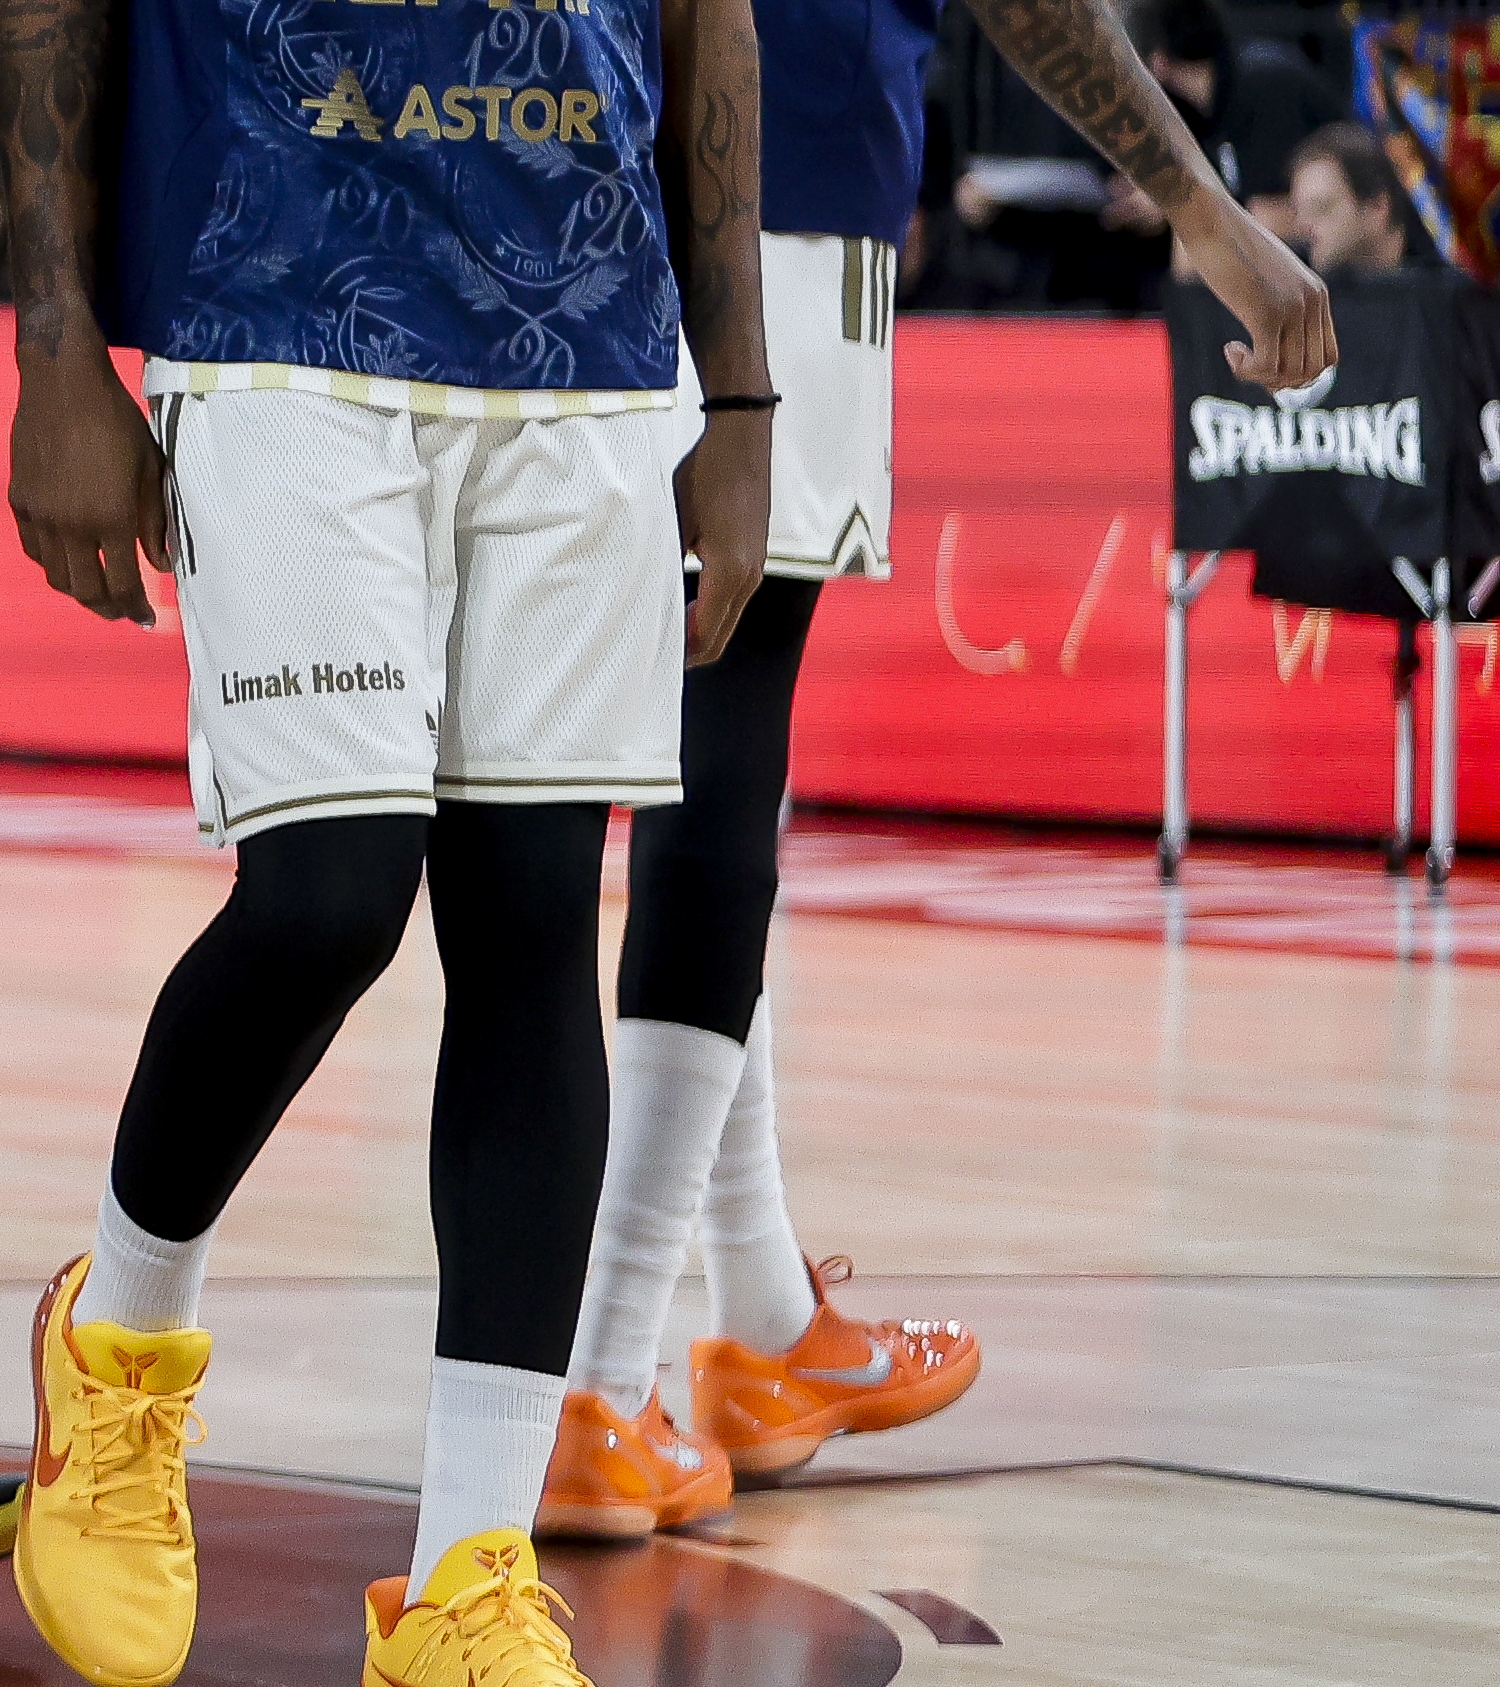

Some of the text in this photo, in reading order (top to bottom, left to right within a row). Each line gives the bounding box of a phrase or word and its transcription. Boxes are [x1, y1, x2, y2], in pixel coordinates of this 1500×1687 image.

[1189, 394, 1427, 485] SPALDING
[220, 660, 406, 707] Limak Hotels
